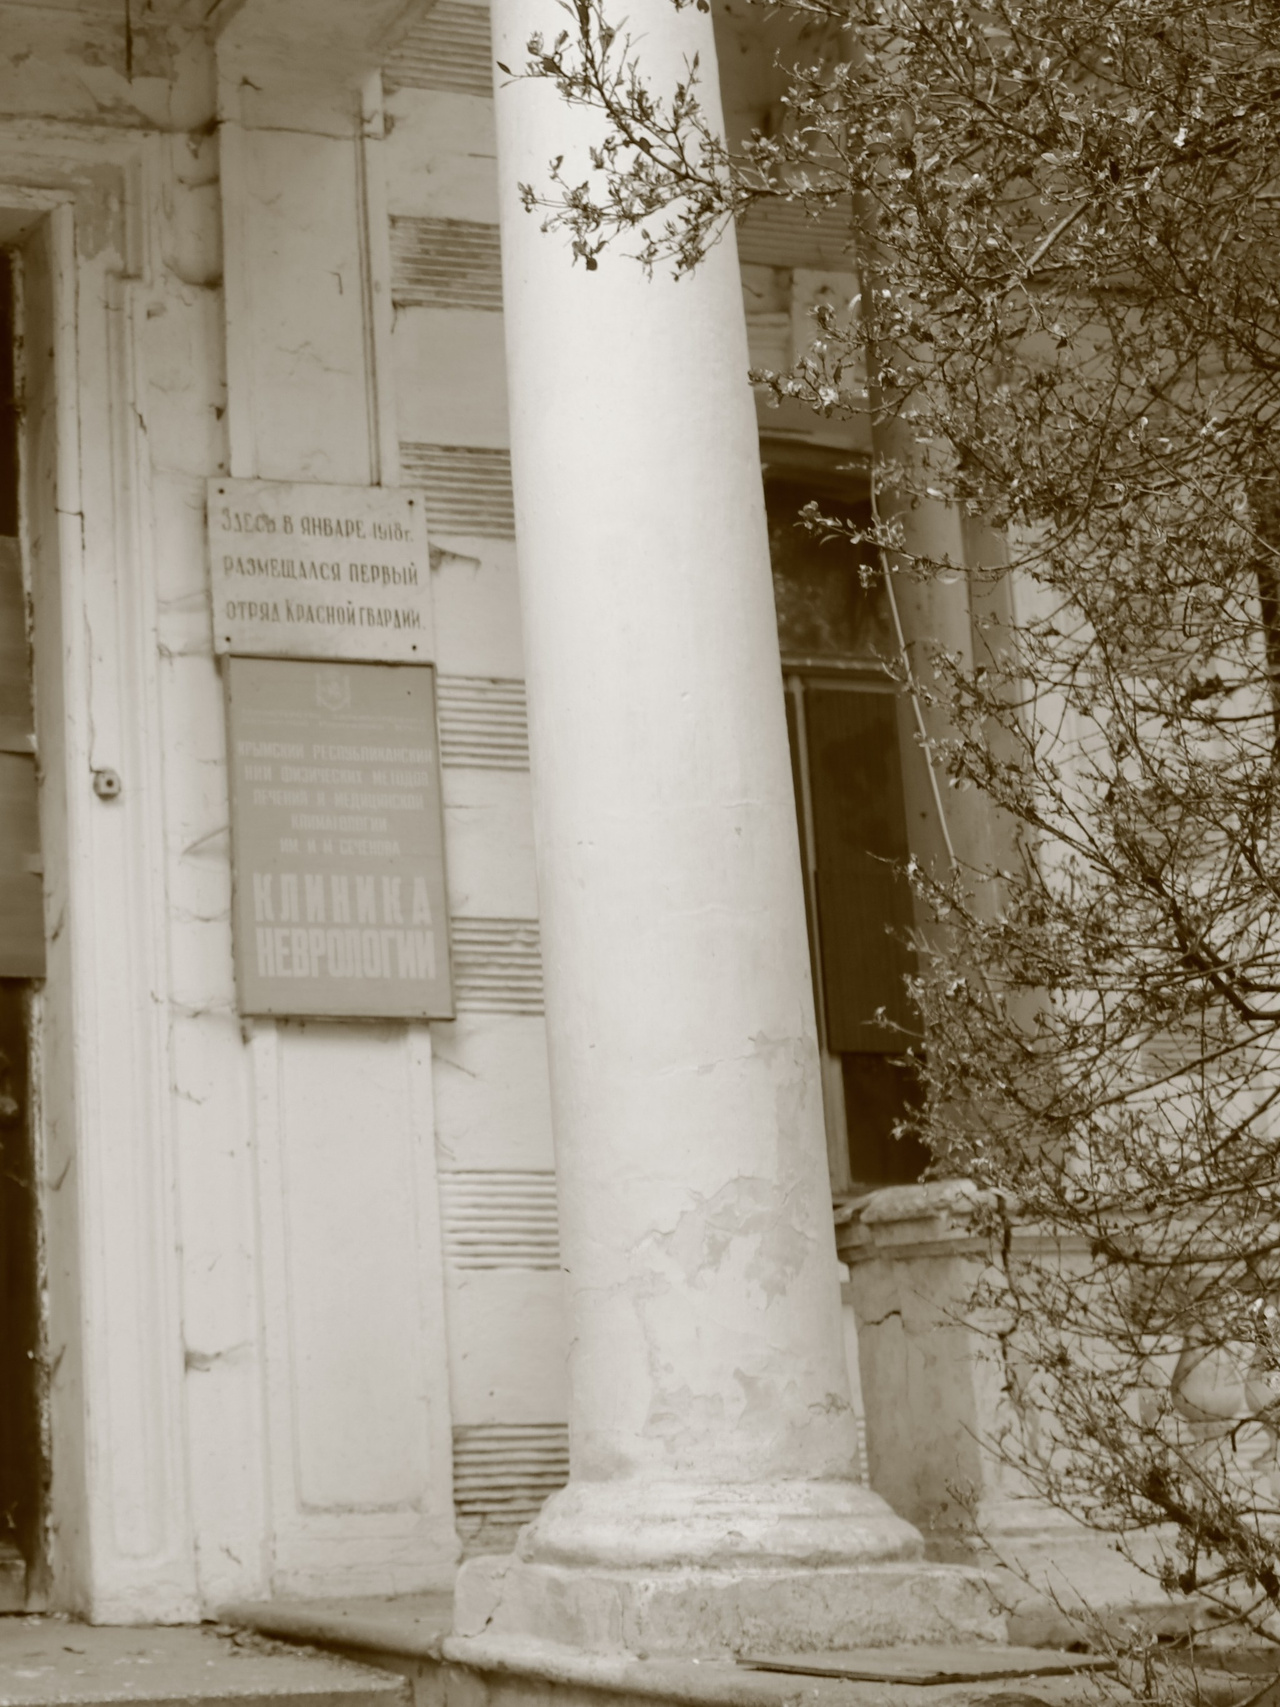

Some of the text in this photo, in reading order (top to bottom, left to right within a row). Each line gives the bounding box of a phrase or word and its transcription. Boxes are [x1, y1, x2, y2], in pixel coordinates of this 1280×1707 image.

[221, 507, 277, 534] ЗДЕСЬ
[283, 514, 294, 535] В
[300, 515, 366, 540] ЯНВАРЕ
[223, 555, 419, 586] РАЗМЕЩАЛСЯ ПЕРВЫЙ
[226, 600, 280, 623] ОТРЯД
[285, 599, 356, 626] КРАСНОЙ
[253, 872, 432, 926] КЛИНИКА
[255, 927, 436, 980] НЕВРОЛОГИИ
